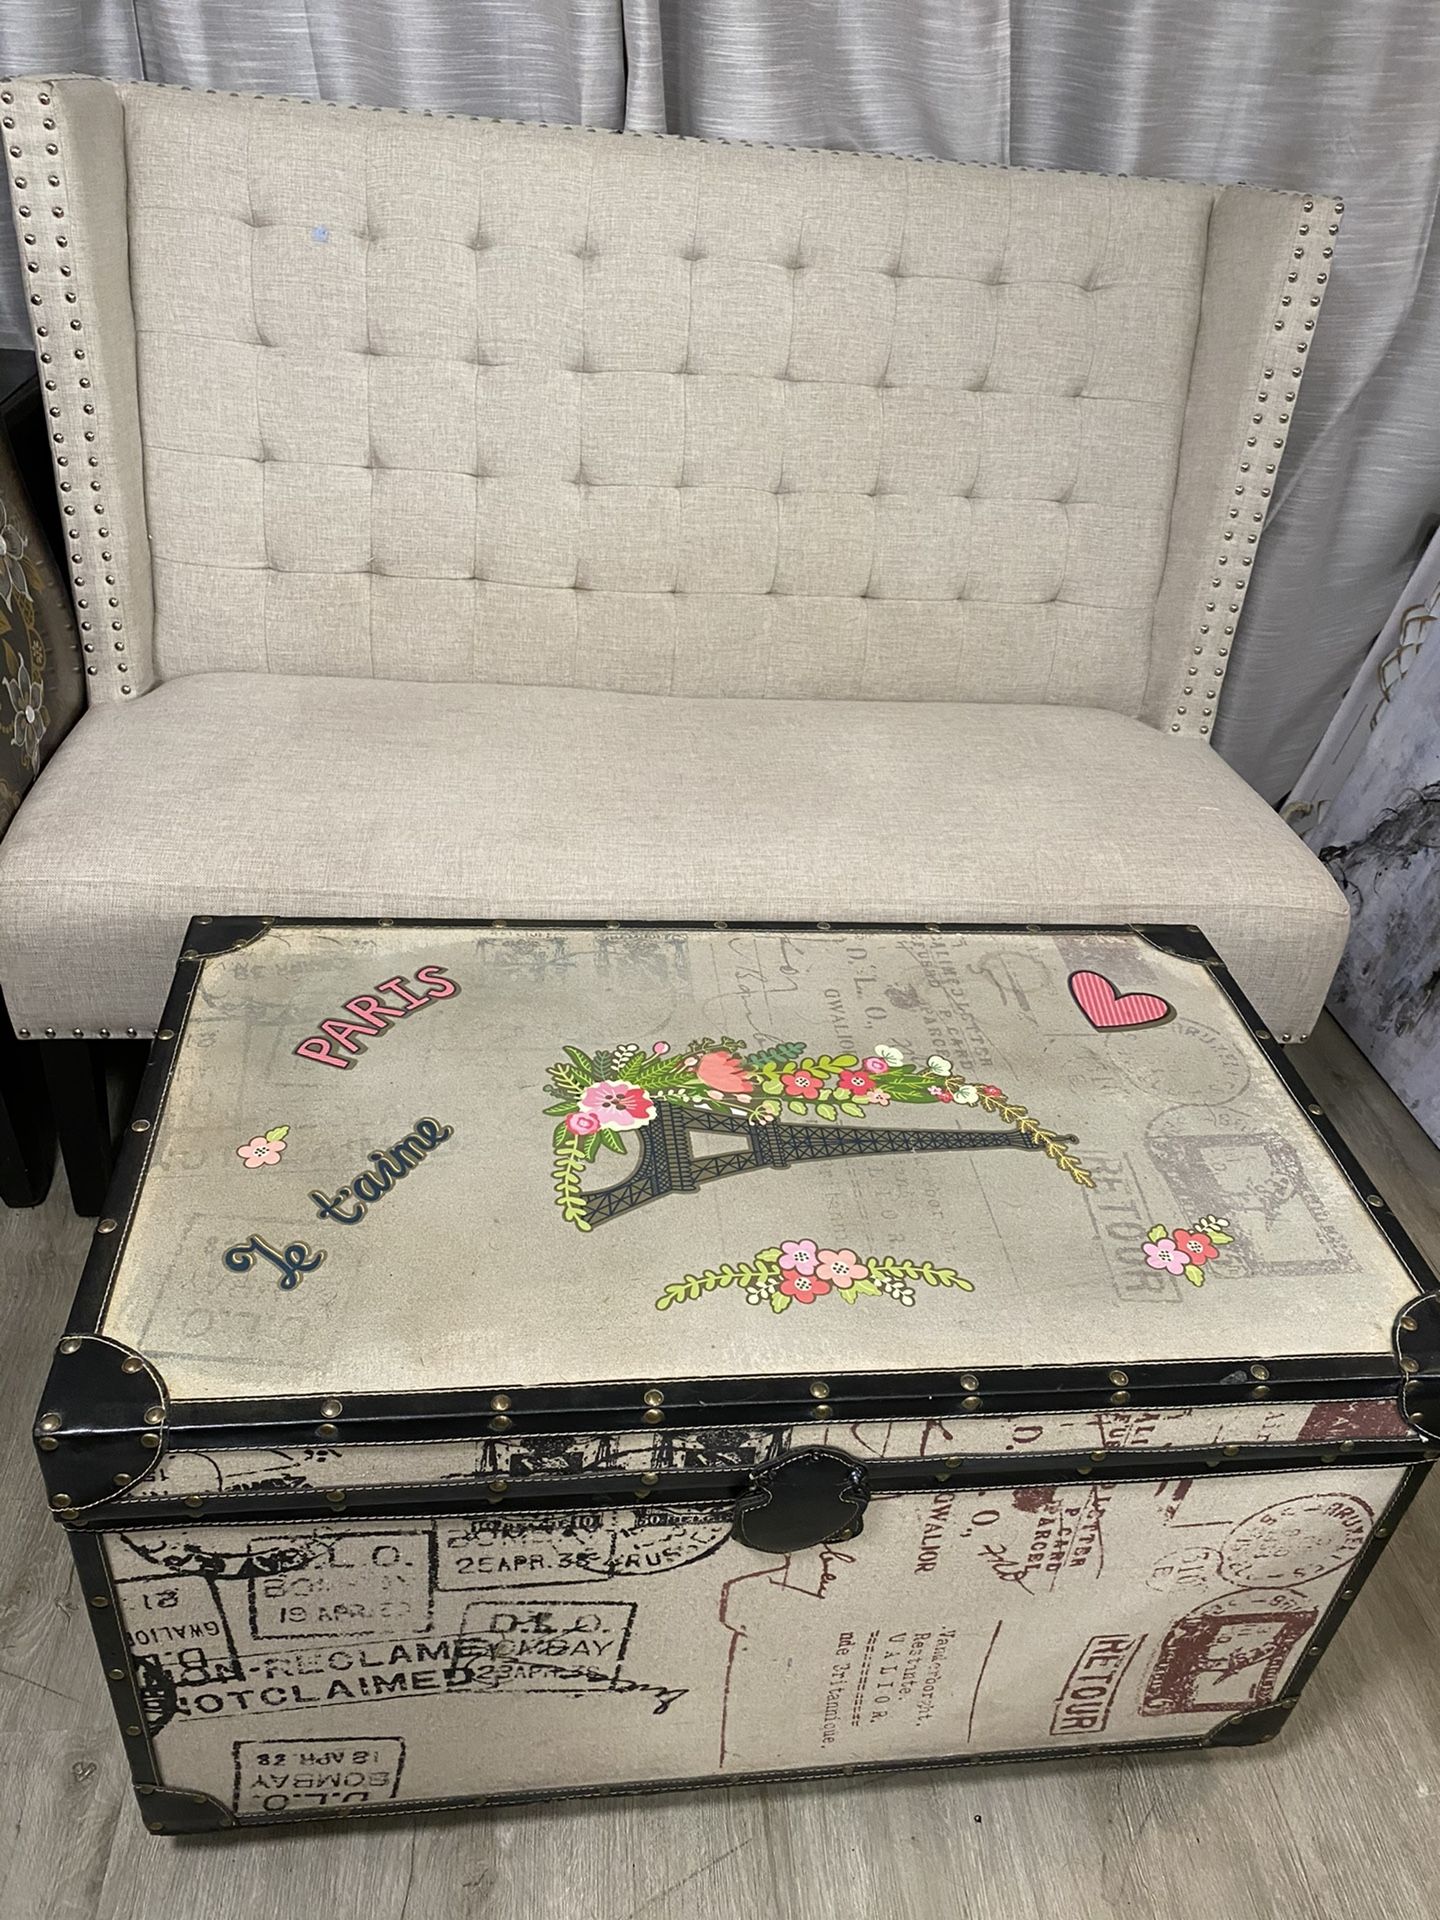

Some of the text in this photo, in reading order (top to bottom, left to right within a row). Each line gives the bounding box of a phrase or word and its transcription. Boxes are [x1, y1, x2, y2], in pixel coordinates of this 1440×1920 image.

[297, 965, 458, 1068] PARIS
[823, 987, 856, 1055] GWALIO
[223, 1116, 454, 1290] Je t'aime
[913, 1492, 956, 1574] GWALIOR
[1059, 1638, 1126, 1732] RETOUR
